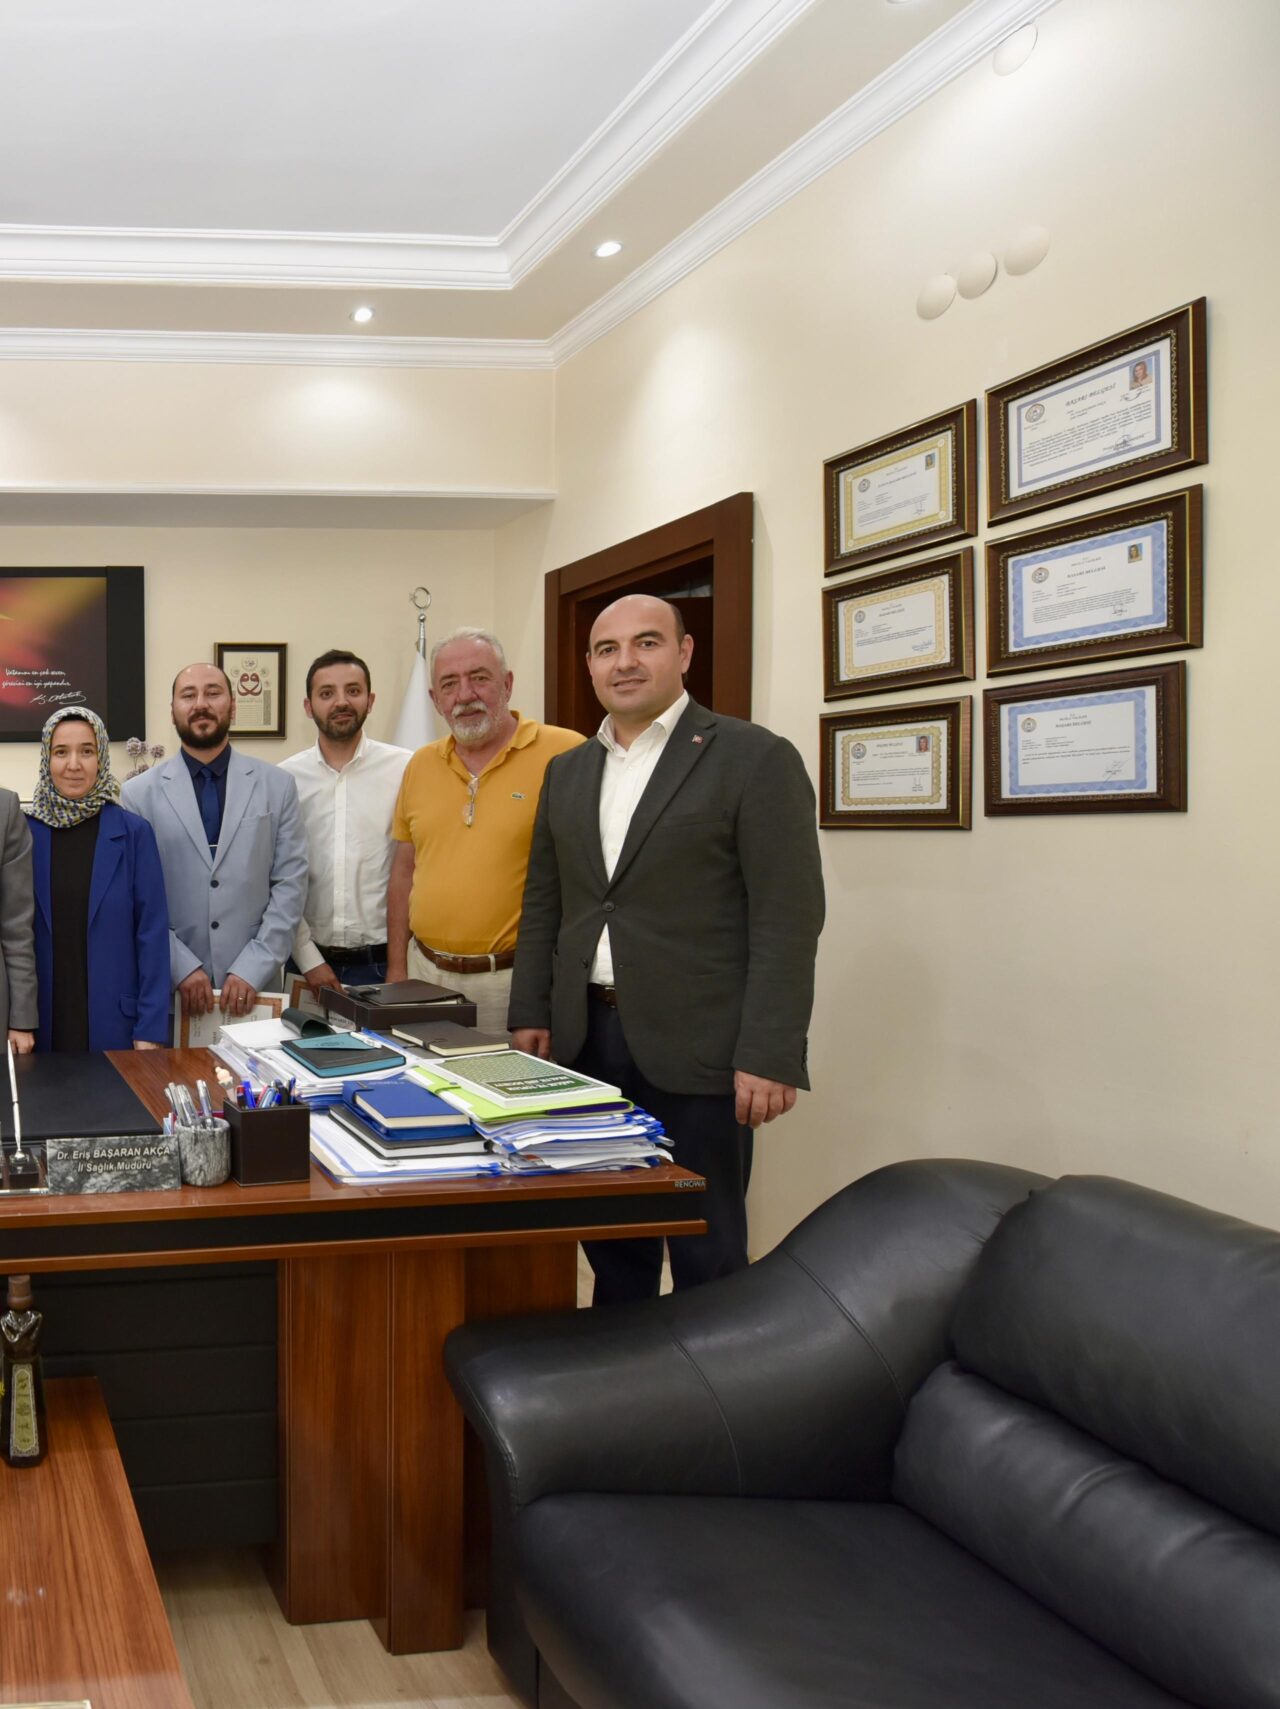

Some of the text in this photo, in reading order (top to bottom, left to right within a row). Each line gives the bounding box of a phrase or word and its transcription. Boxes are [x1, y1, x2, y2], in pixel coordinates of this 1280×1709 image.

[57, 1146, 170, 1161] Dr. Eriş BAŞARAN AKÇA
[86, 1161, 115, 1174] Sağlık
[117, 1160, 152, 1171] Müdürü
